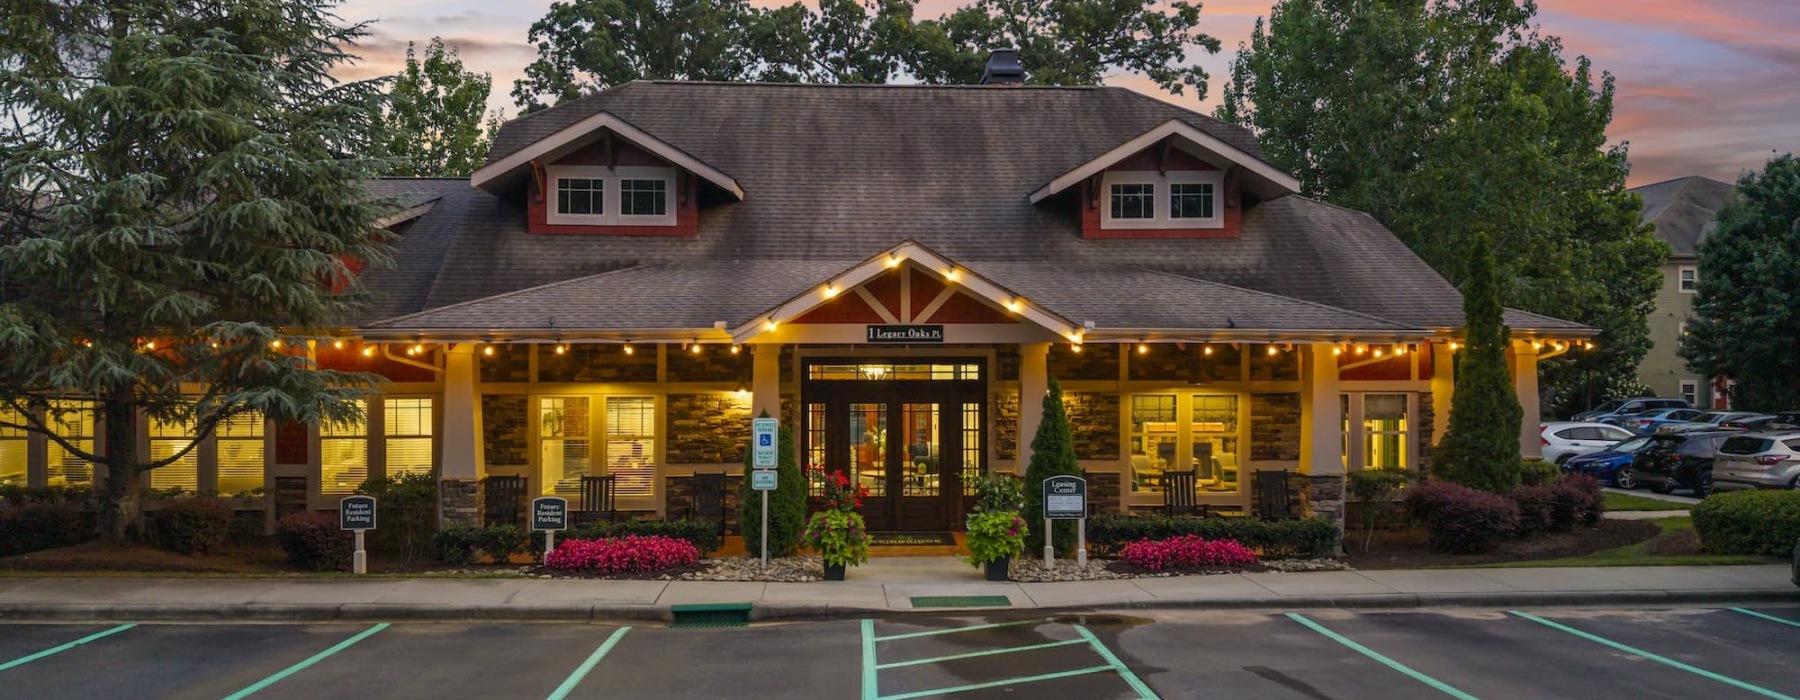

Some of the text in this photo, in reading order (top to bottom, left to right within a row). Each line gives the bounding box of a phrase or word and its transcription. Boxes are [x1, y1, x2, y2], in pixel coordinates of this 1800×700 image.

[869, 328, 874, 339] 1
[876, 329, 906, 339] Legacy
[908, 328, 930, 339] Oaks
[1051, 480, 1077, 489] Leasing
[346, 515, 370, 523] Parking
[538, 516, 561, 524] Parking
